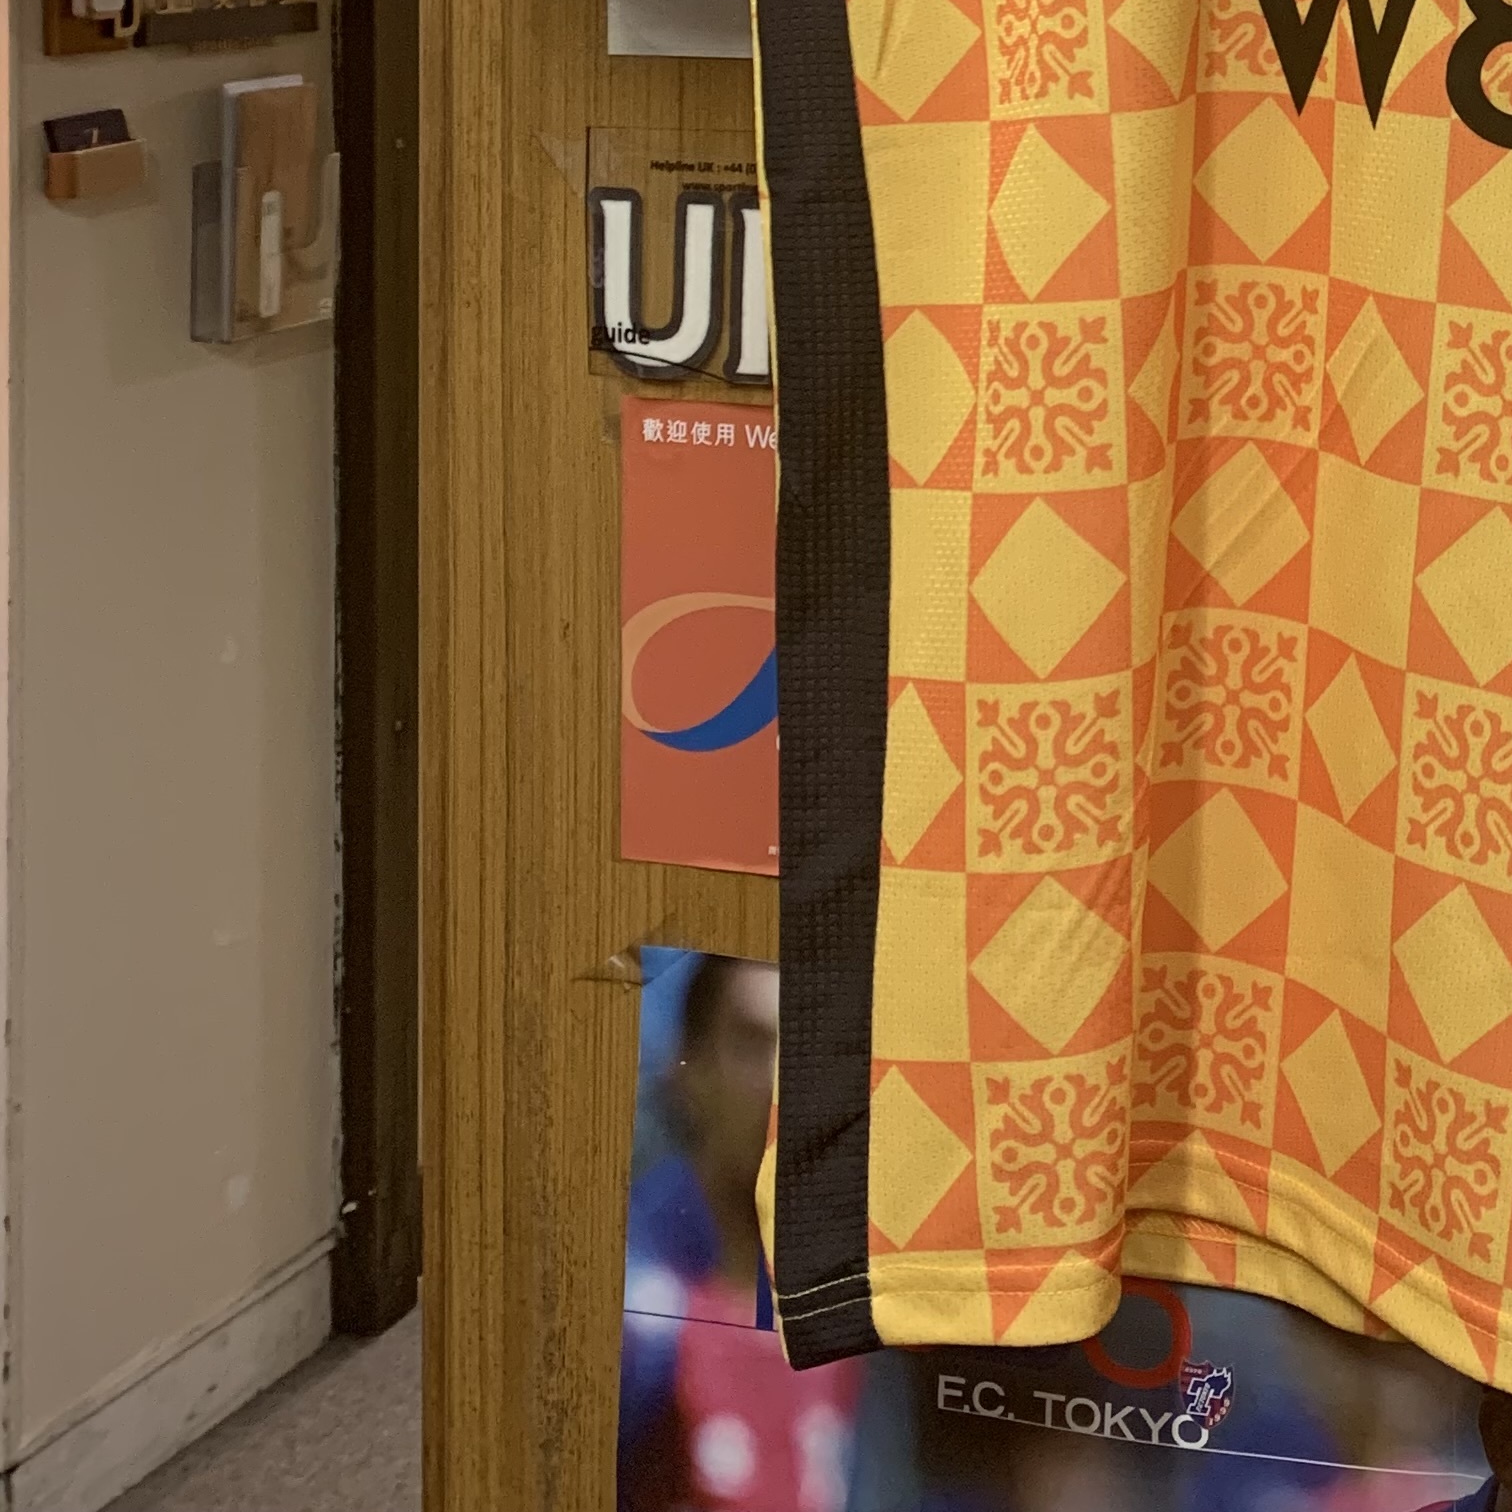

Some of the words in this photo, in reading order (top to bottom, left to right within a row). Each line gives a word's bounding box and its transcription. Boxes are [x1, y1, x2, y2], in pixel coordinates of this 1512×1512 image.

[590, 321, 652, 346] guide
[641, 417, 736, 448] 歡迎使用
[936, 1373, 1017, 1421] F.C.
[1032, 1389, 1209, 1449] TOKYO
